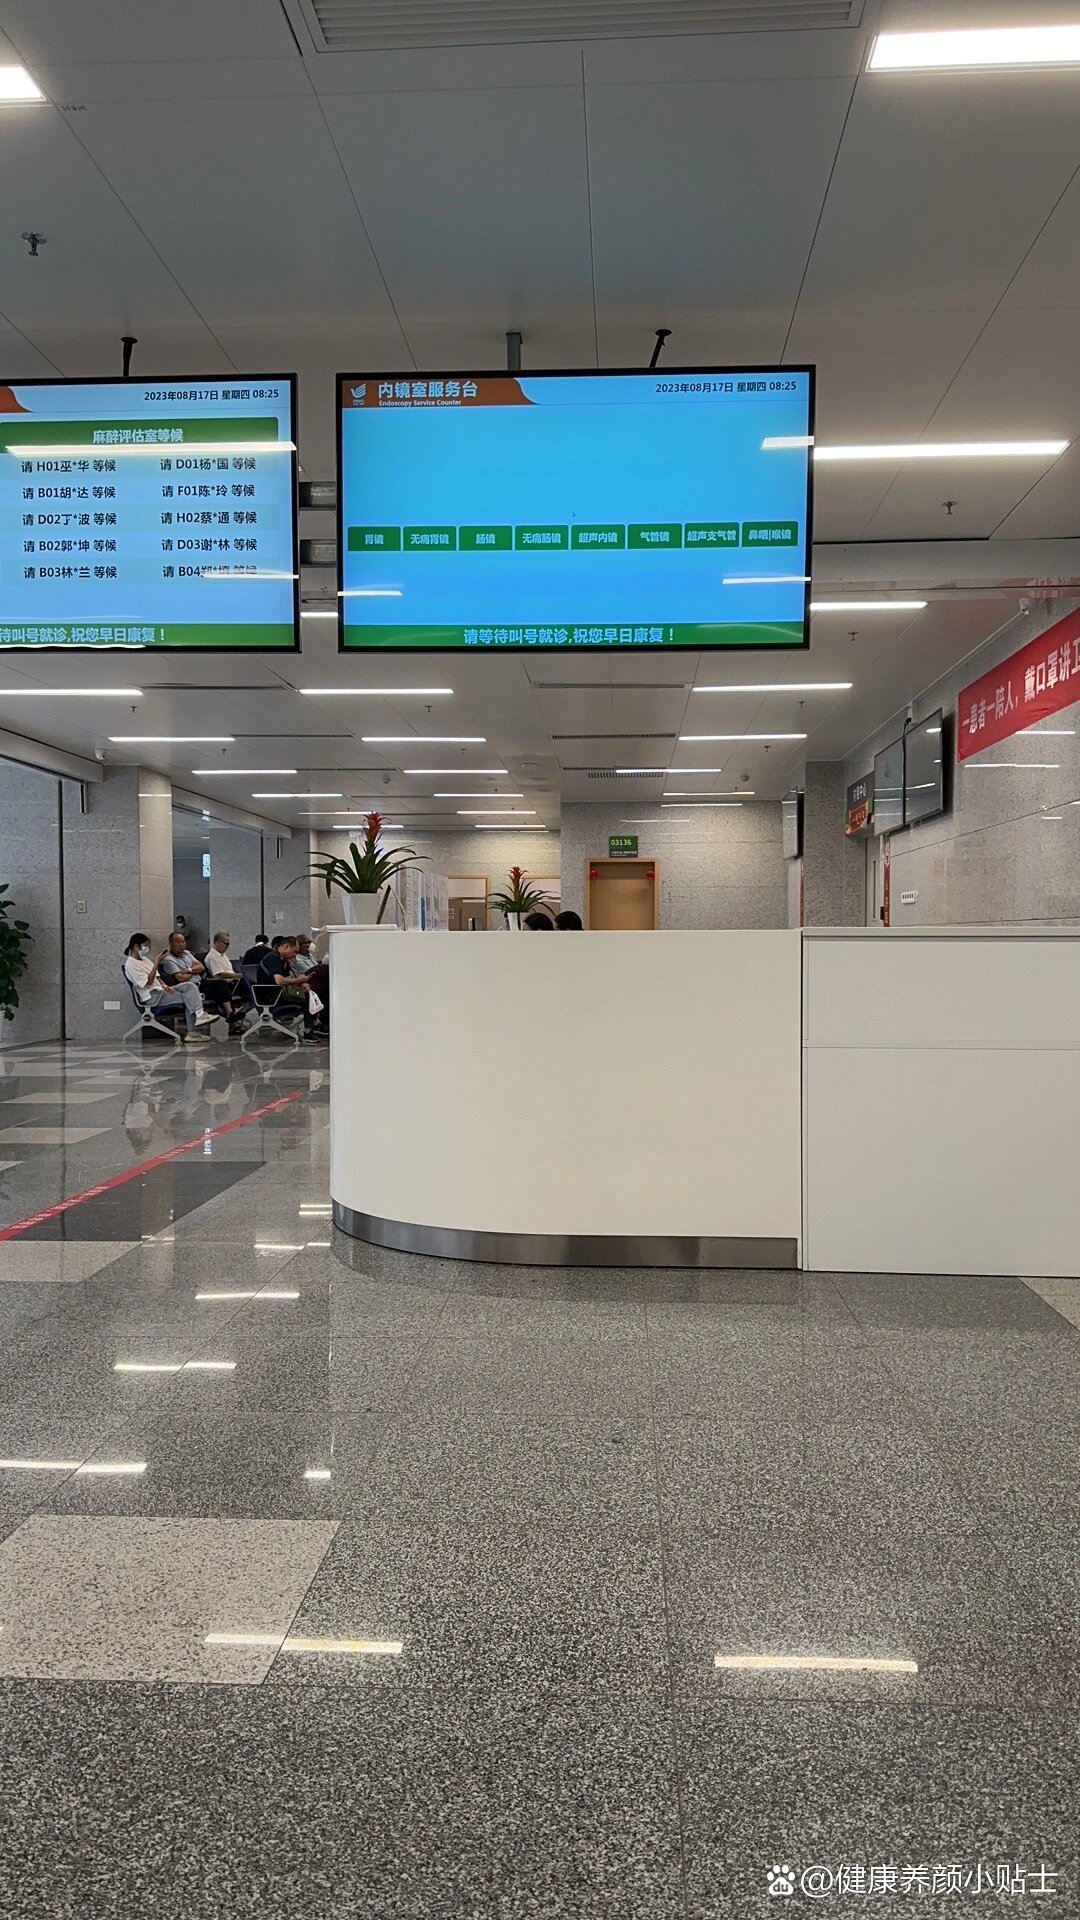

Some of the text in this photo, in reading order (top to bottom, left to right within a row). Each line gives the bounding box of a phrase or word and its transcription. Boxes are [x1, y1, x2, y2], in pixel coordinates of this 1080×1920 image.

[378, 381, 478, 398] 内镜室服务台
[655, 381, 796, 393] 2023年08月17日 星期四 08:25
[144, 389, 279, 401] 2023年08月17日 星期四 08:25
[93, 428, 183, 444] 麻醉评估室等候
[21, 460, 33, 473] 请
[93, 459, 116, 472] 等候
[160, 459, 171, 470] 请
[232, 457, 256, 470] 等候
[22, 487, 34, 499] 请
[92, 486, 116, 499] 等候
[162, 485, 173, 497] 请
[231, 484, 255, 497] 等候
[22, 514, 34, 526] 请
[93, 512, 117, 525] 等候
[161, 512, 173, 524] 请
[233, 511, 257, 524] 等候
[364, 534, 384, 545] 胃镜
[410, 533, 449, 545] 无痛胃镜
[475, 533, 496, 544] 肠镜
[522, 532, 561, 544] 无痛肠镜
[578, 531, 617, 543] 超声内镜
[640, 531, 669, 542] 气管镜
[687, 530, 736, 542] 超声支气管
[23, 540, 35, 552] 请
[93, 539, 117, 552] 等候
[161, 539, 173, 551] 请
[233, 538, 257, 551] 等候
[24, 566, 35, 579] 请
[93, 566, 117, 578] 等候
[162, 566, 174, 578] 请
